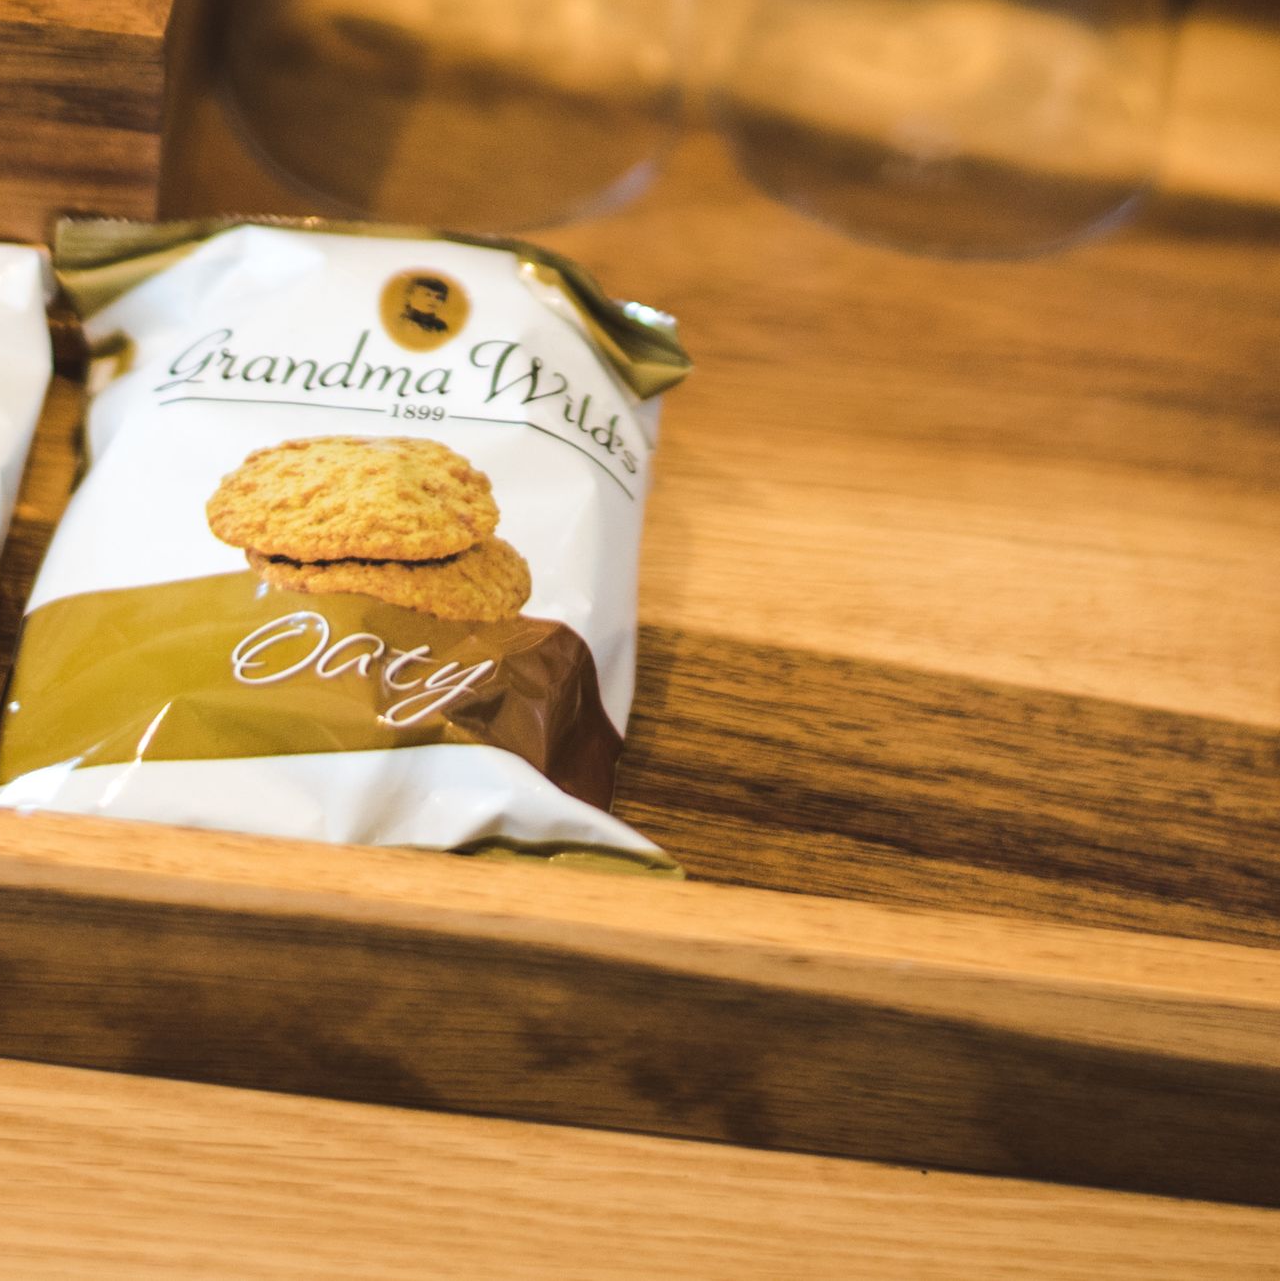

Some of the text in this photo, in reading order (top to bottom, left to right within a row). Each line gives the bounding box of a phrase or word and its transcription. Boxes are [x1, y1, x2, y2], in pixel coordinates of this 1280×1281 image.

[153, 328, 455, 400] Grandma
[388, 402, 446, 423] 1899
[230, 609, 496, 729] Oaty
